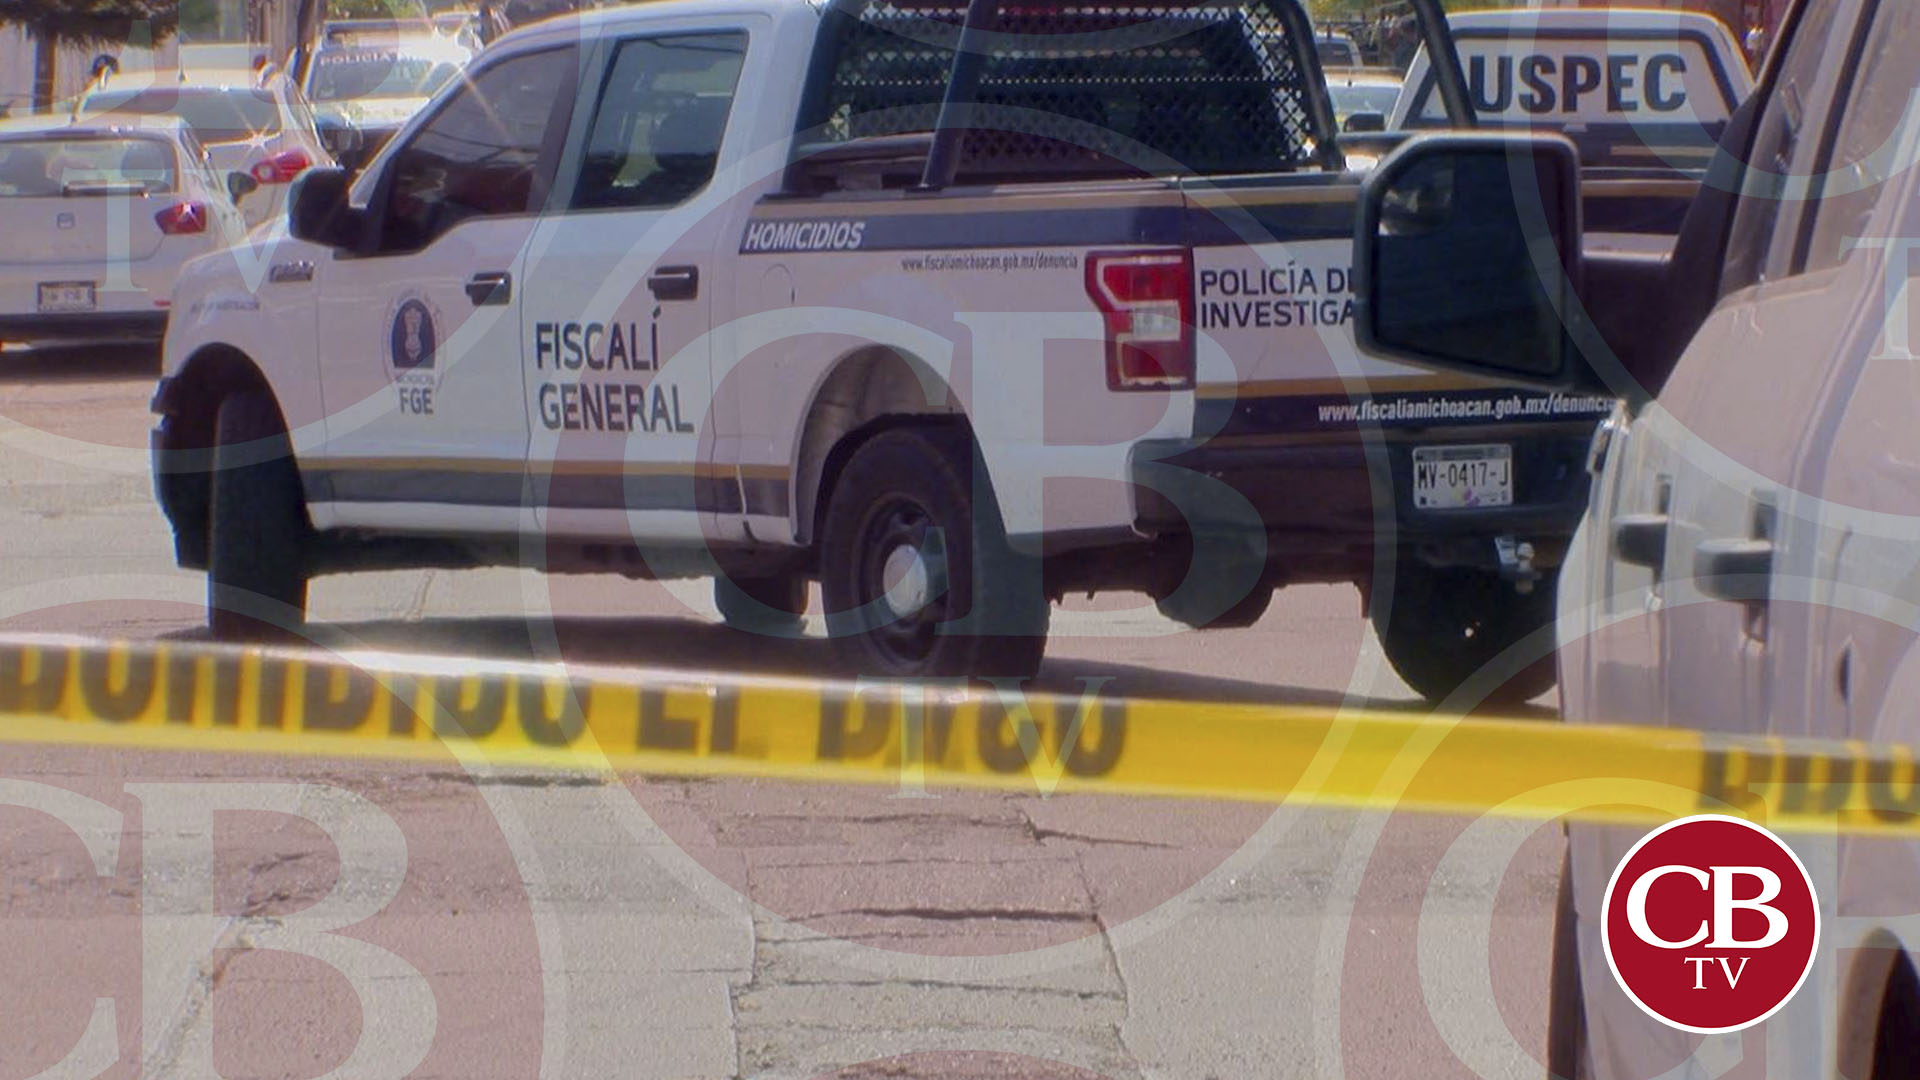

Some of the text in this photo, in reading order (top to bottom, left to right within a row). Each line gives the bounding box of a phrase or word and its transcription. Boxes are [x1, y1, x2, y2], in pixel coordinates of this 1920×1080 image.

[1469, 54, 1687, 113] USPEC
[744, 221, 866, 251] HOMICIDIOS
[1200, 260, 1317, 296] POLICÍA
[535, 305, 662, 371] FISCALÍ
[399, 386, 435, 415] FGE
[539, 382, 695, 433] GENERAL
[1418, 461, 1509, 489] MV-0417-J
